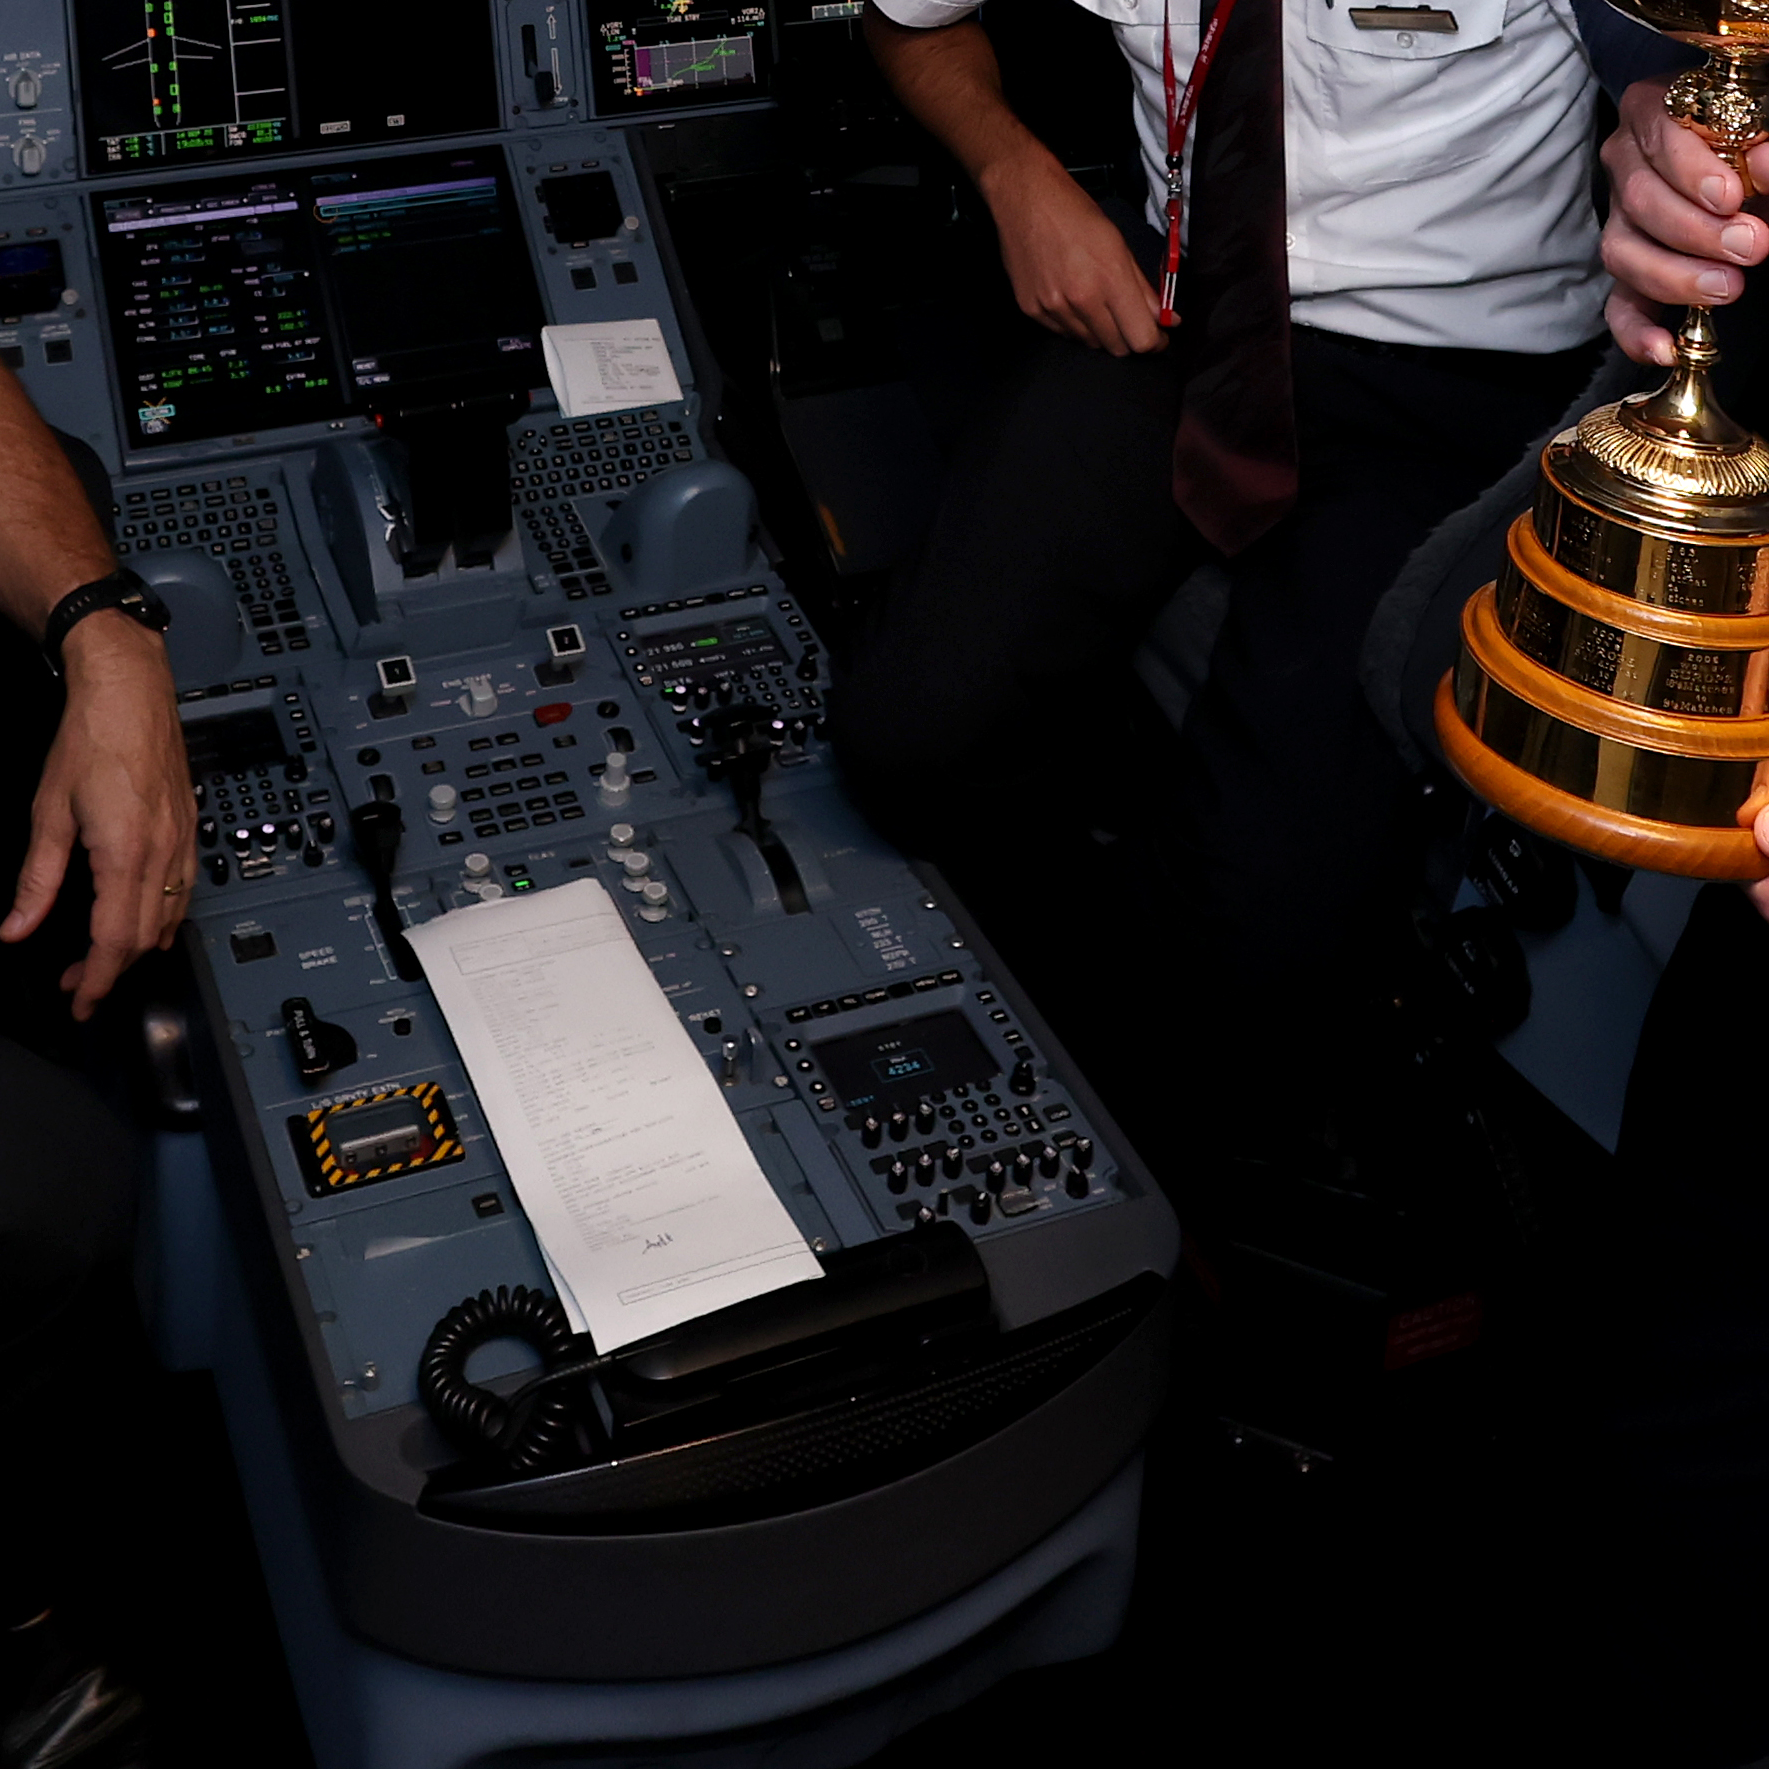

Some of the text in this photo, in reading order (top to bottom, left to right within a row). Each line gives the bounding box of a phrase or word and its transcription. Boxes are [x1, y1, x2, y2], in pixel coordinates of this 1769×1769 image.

[298, 945, 335, 961] SPEED
[300, 954, 338, 970] BRAKE
[370, 1081, 401, 1096] EXTN
